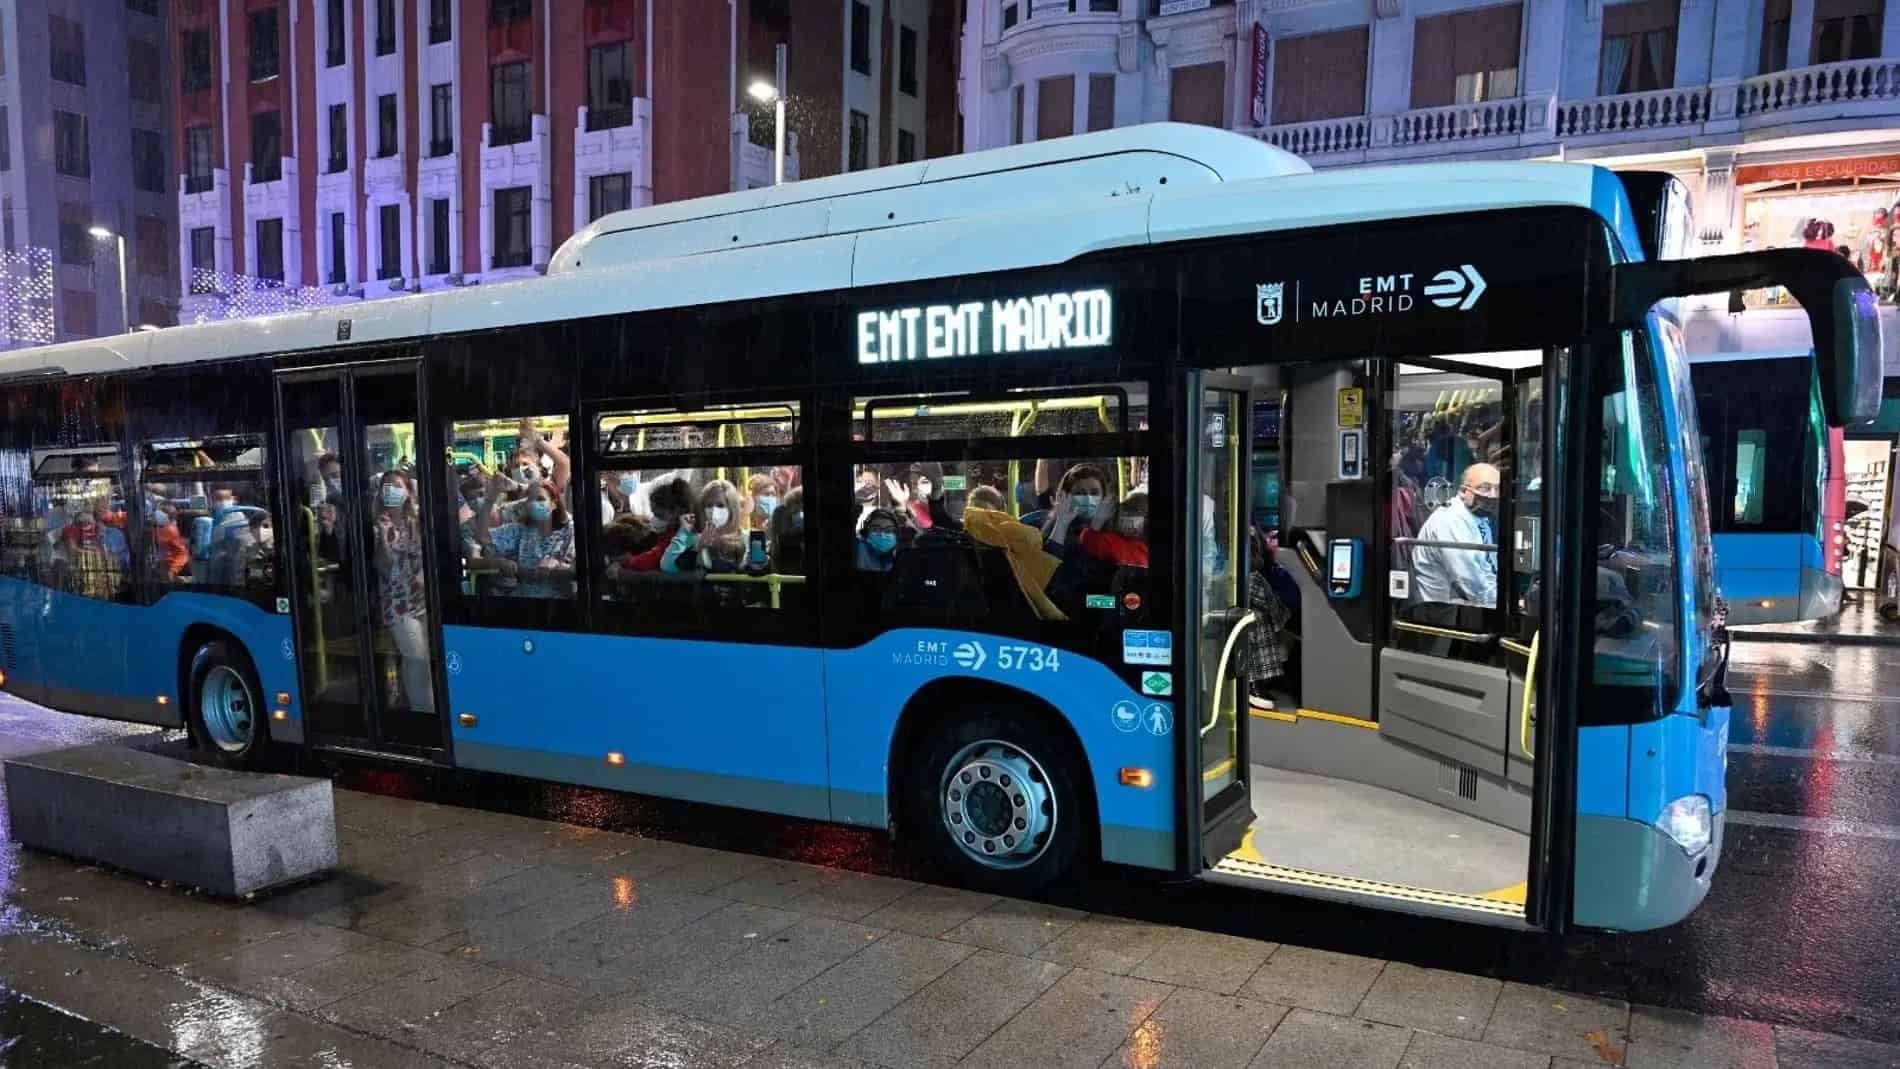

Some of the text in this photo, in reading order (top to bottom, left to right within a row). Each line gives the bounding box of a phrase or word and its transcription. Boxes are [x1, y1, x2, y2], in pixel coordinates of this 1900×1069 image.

[1359, 273, 1414, 294] EMT
[1312, 294, 1414, 318] MADRID
[858, 289, 1112, 364] EMT EMT MADRID
[918, 640, 948, 652] EMT
[892, 652, 948, 666] MADRID
[998, 645, 1060, 672] 5734
